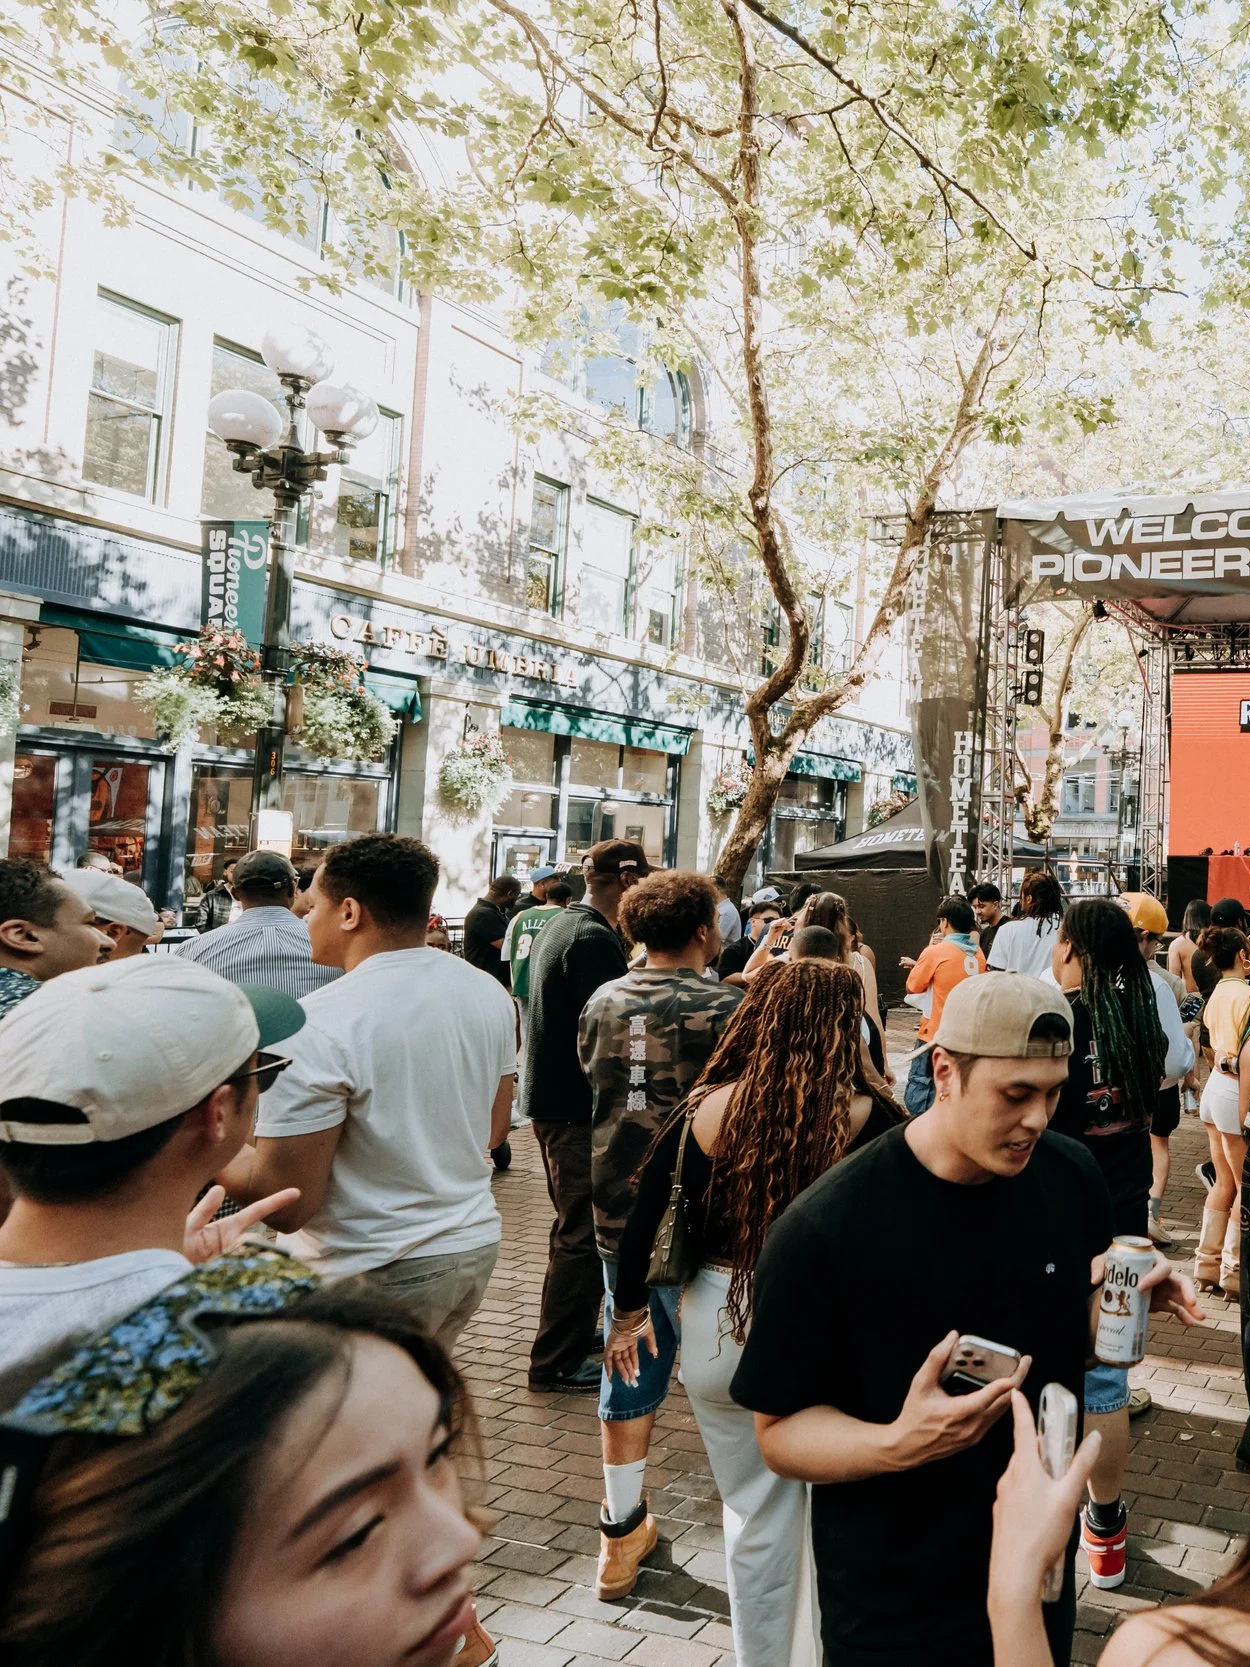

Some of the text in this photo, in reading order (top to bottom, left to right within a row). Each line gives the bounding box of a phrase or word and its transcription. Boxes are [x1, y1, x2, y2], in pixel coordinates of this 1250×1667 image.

[1032, 547, 1250, 583] PIONEER
[910, 527, 931, 702] OMETEAM
[330, 614, 581, 688] CAFFÈ UMBRIA
[269, 751, 277, 776] 306
[948, 731, 973, 898] HOMETEA
[852, 828, 949, 849] HOMETEM
[522, 918, 546, 931] ALLE
[1104, 1264, 1138, 1287] delo
